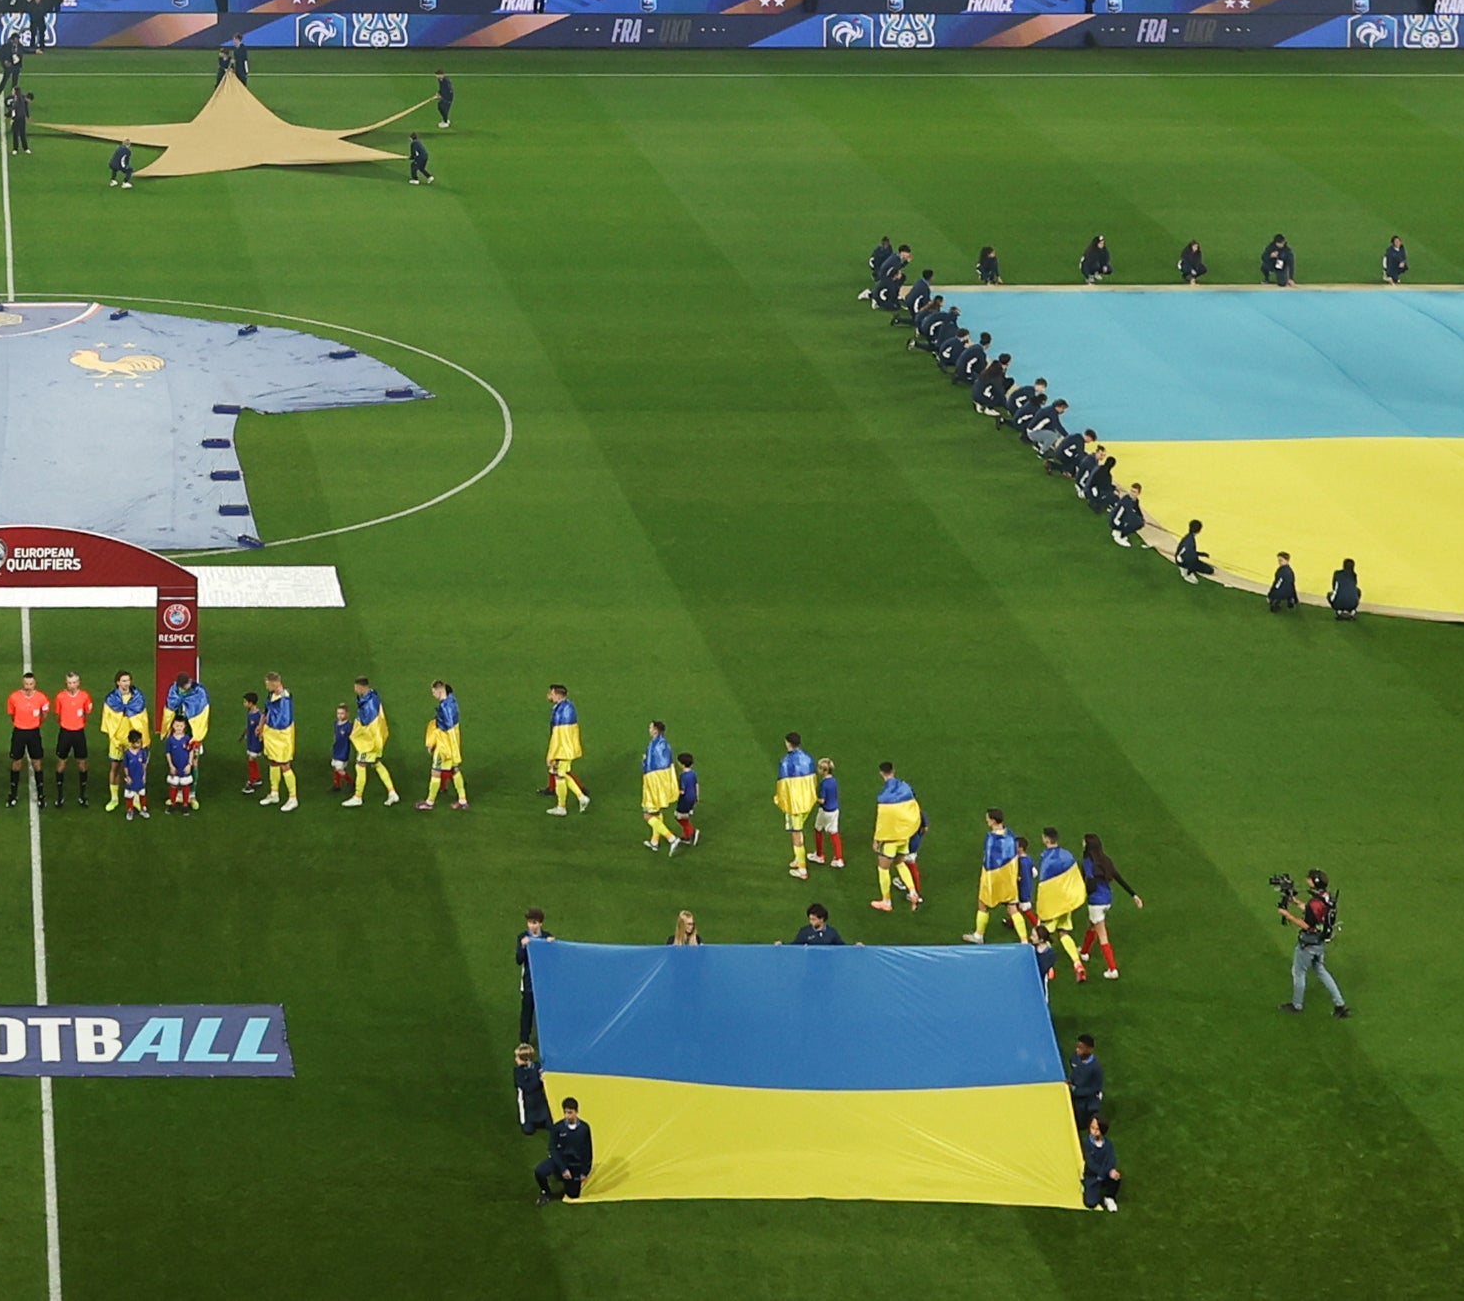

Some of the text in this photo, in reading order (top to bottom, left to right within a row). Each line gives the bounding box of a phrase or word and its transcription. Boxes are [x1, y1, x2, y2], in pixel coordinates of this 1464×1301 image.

[611, 18, 642, 42] FRA
[1137, 18, 1167, 42] FRA
[14, 548, 73, 557] EUROPEAN
[6, 559, 81, 571] QUALIFIERS
[159, 634, 195, 642] RESPECT
